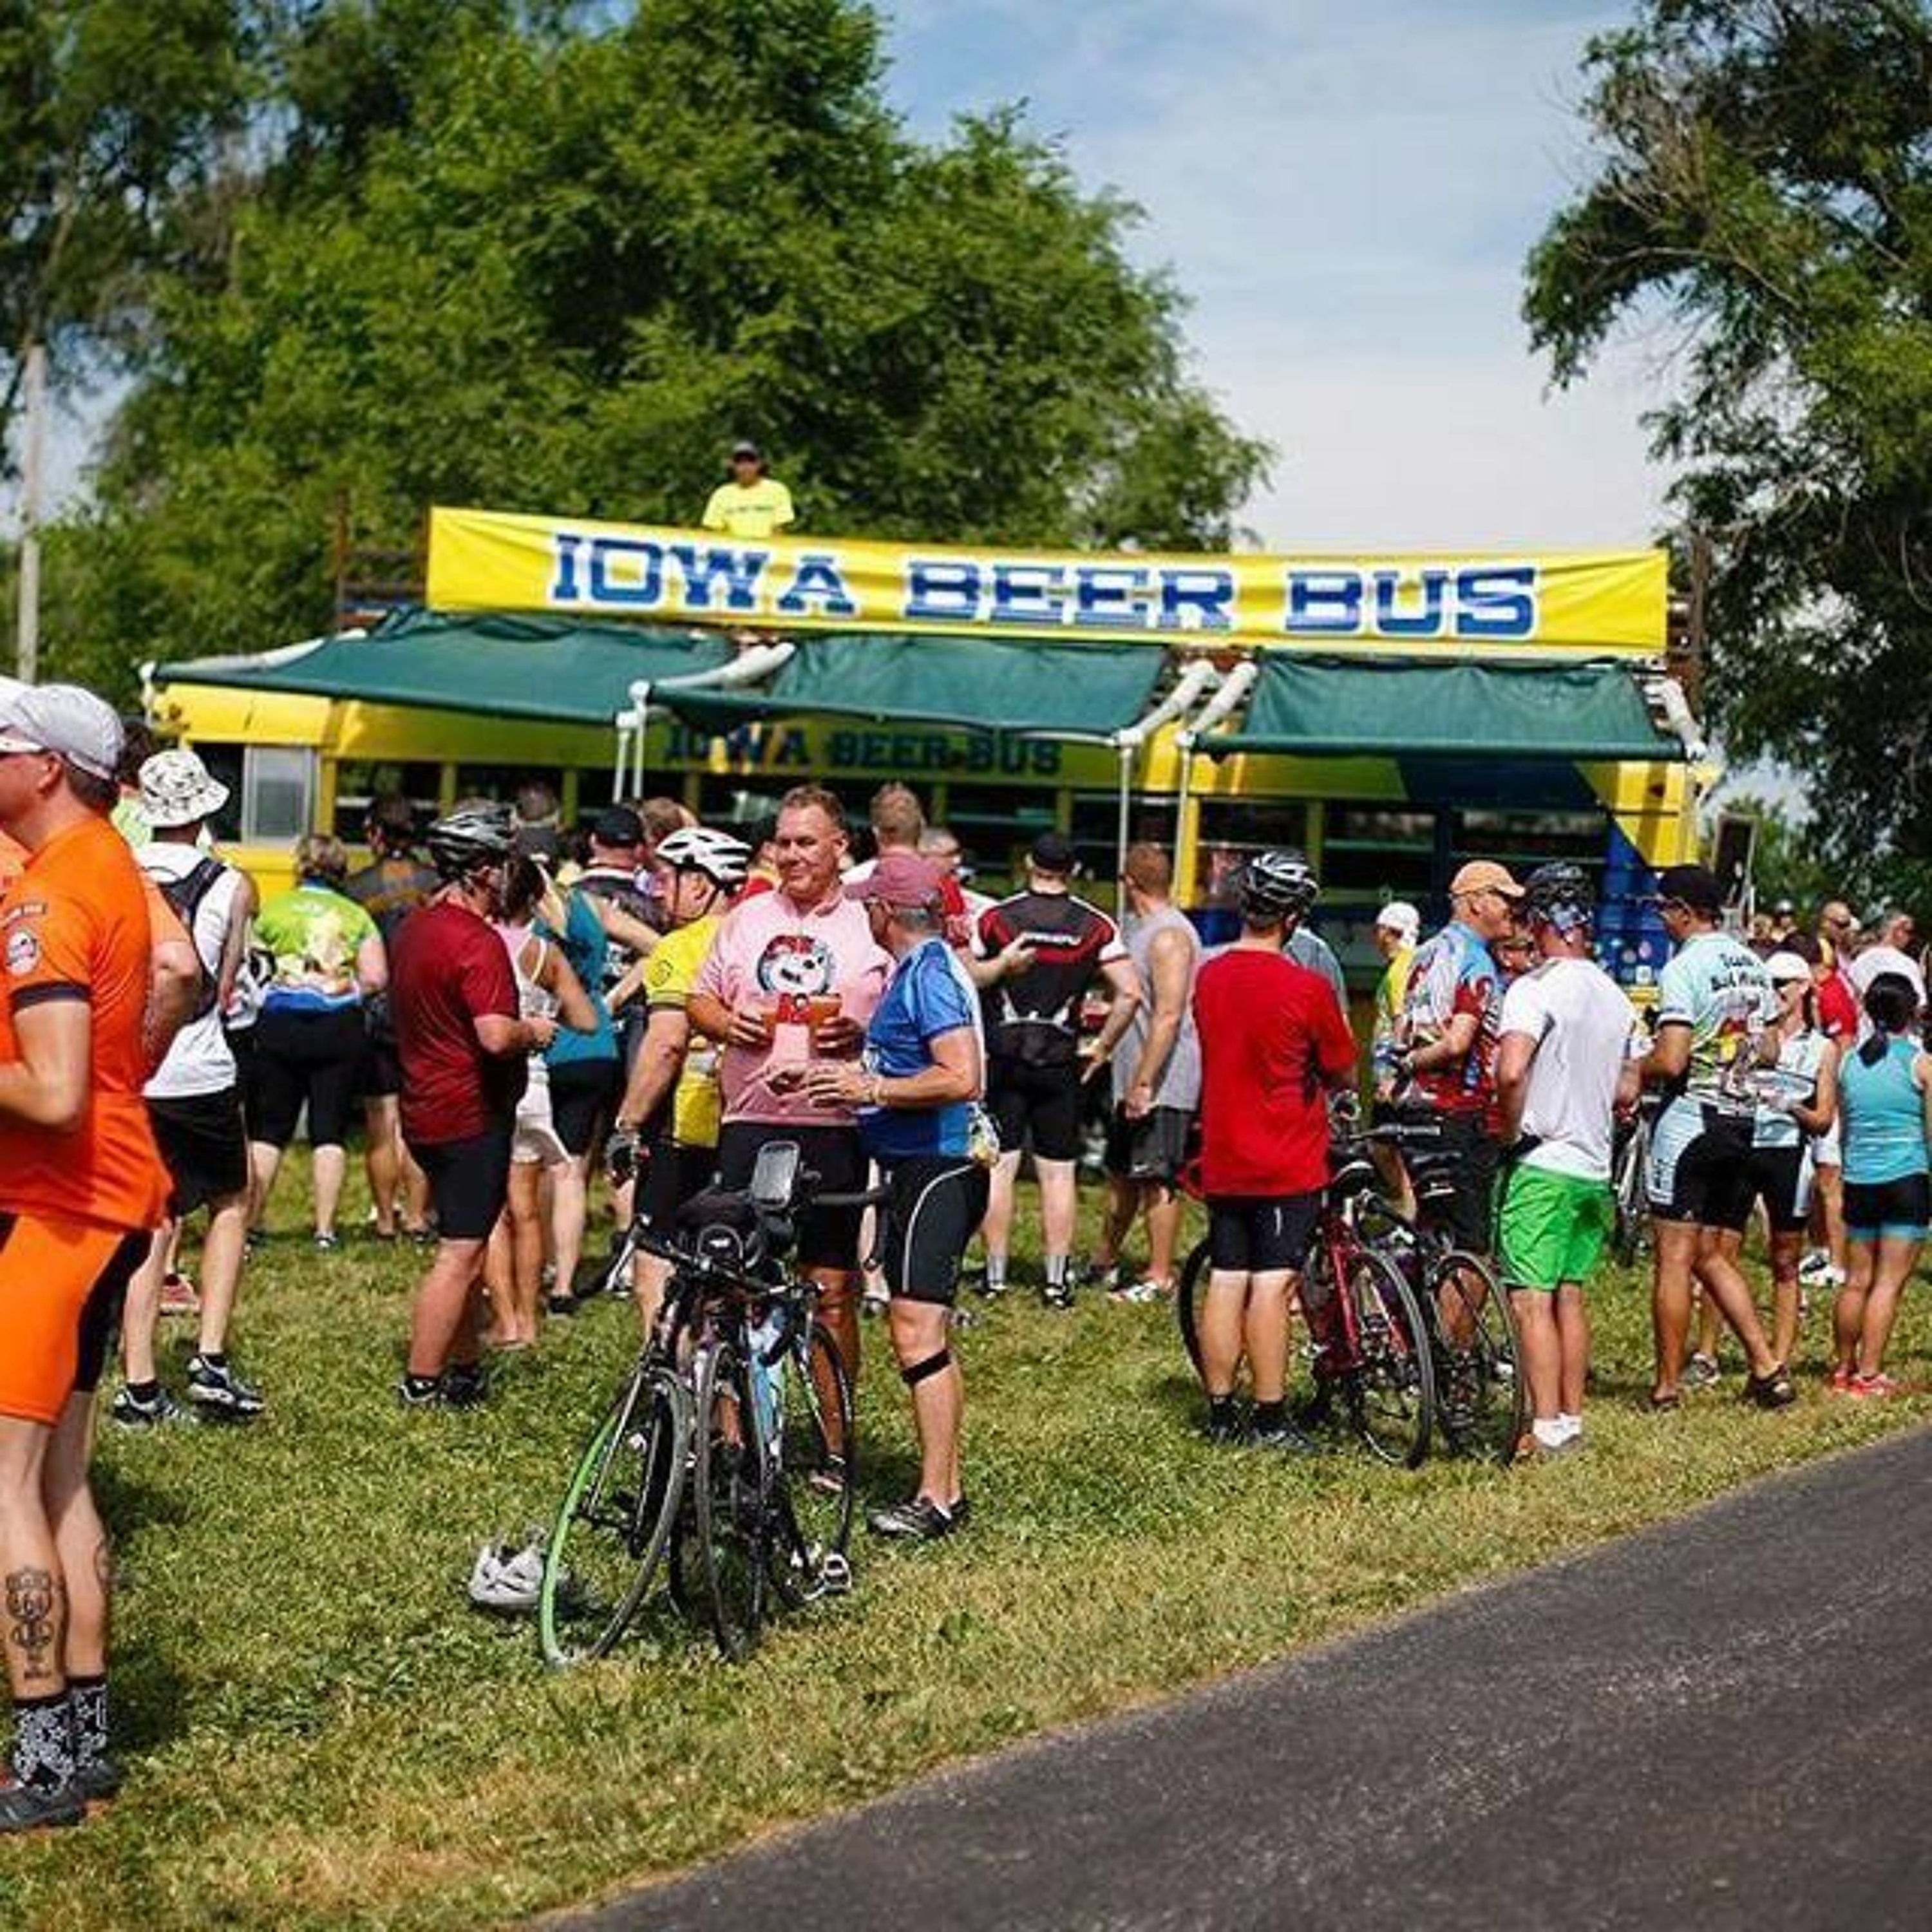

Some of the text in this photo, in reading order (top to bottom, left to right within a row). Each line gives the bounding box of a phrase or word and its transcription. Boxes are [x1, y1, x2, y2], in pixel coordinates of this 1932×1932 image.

[551, 532, 1537, 636] IOWA BEER BUS
[831, 730, 951, 770] BEER
[967, 733, 1063, 776] BUS
